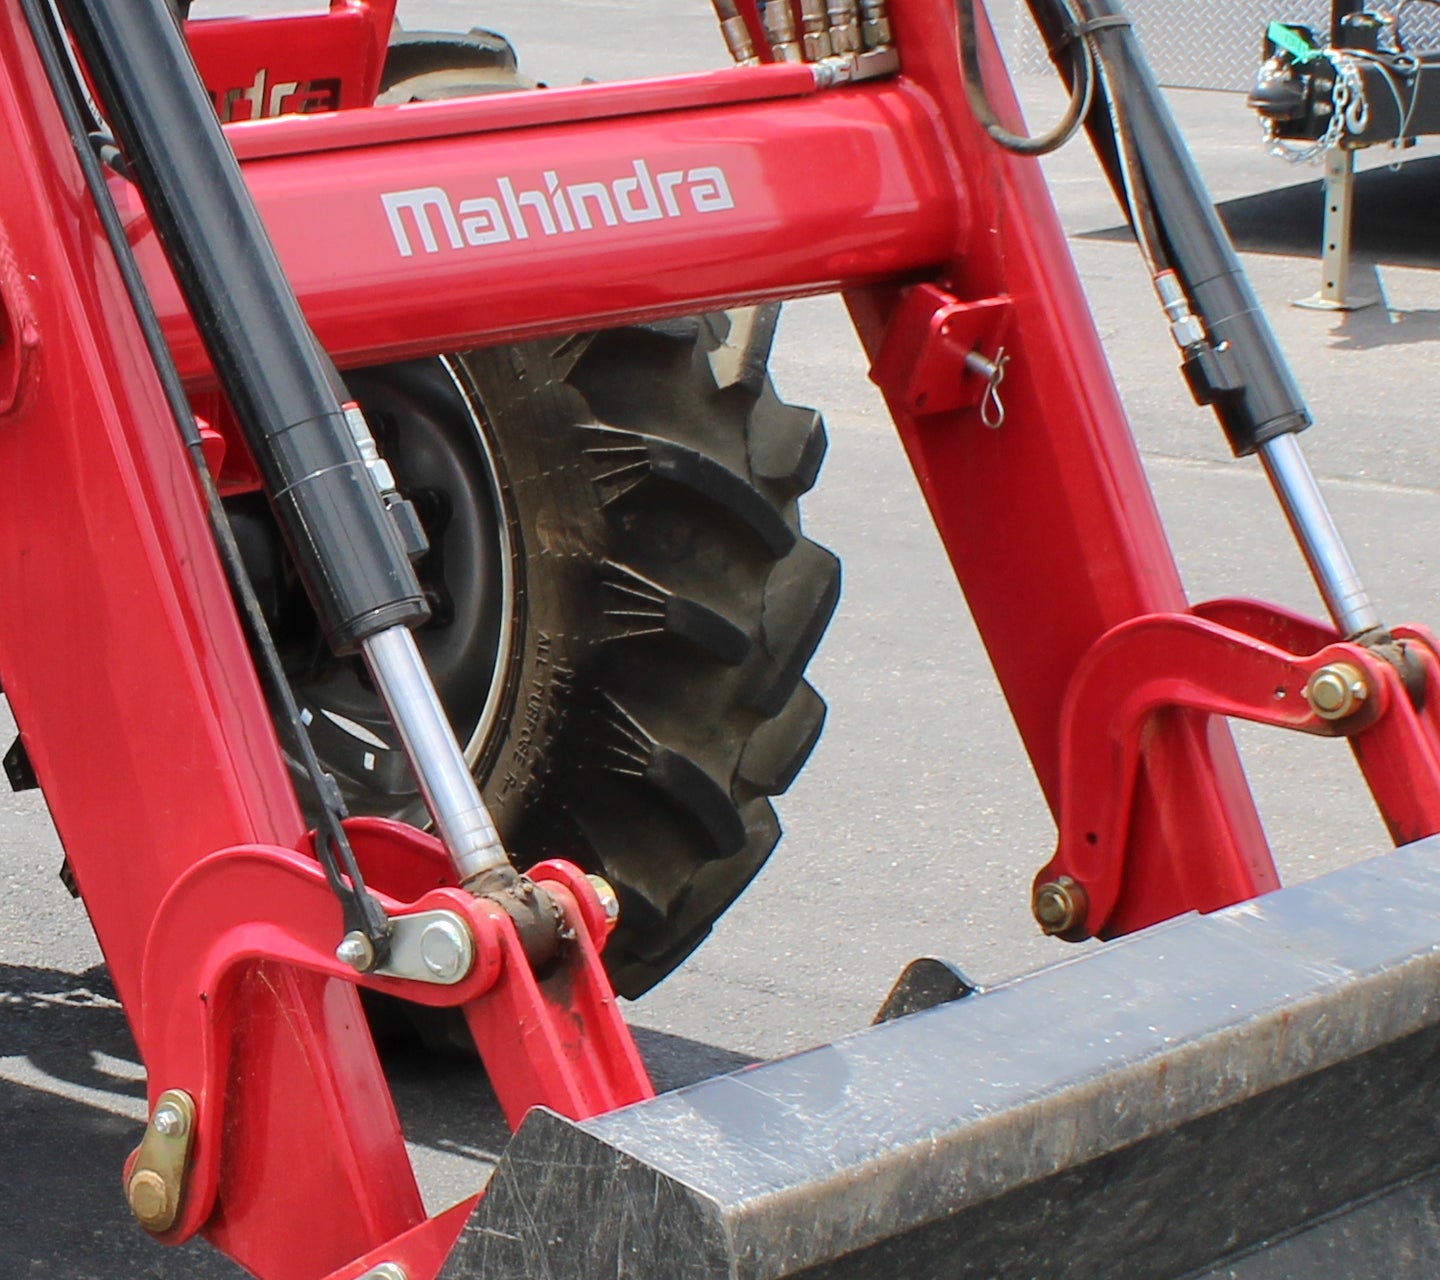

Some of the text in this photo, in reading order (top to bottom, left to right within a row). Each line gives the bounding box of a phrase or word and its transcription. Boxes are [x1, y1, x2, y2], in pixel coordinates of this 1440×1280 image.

[381, 158, 735, 257] Mahindra
[535, 630, 551, 668] ALL
[513, 679, 545, 767] PURPOSE
